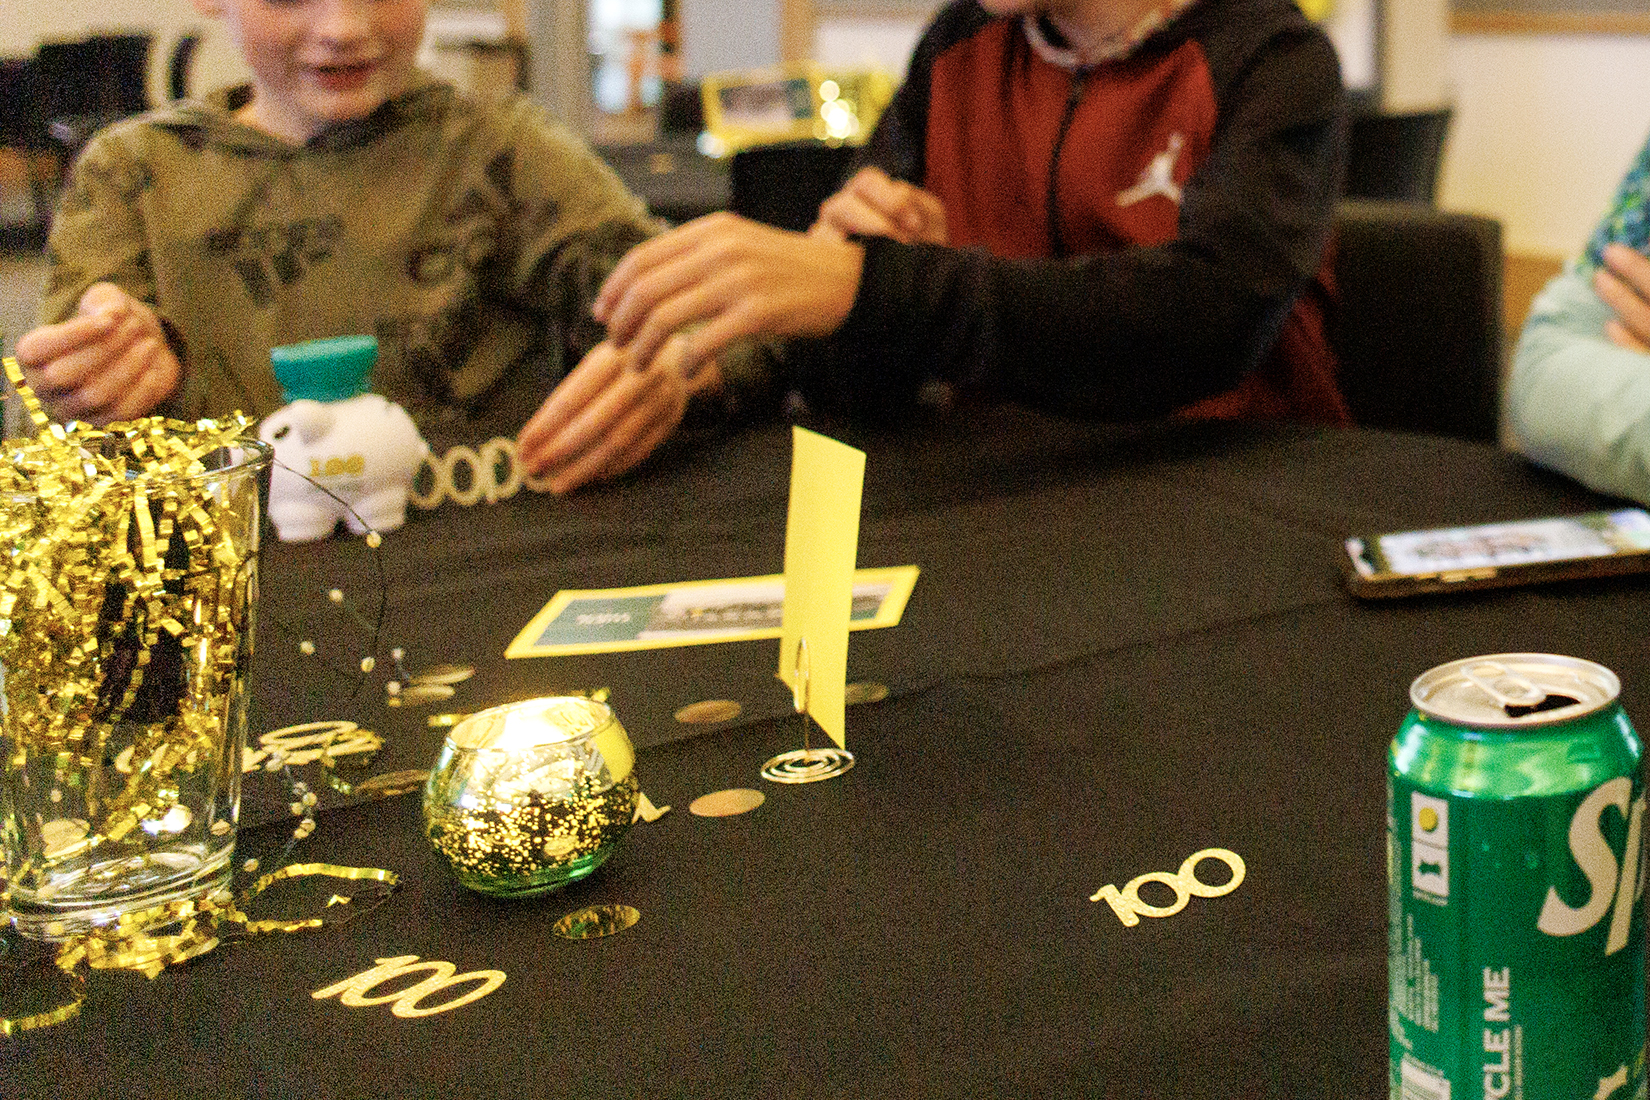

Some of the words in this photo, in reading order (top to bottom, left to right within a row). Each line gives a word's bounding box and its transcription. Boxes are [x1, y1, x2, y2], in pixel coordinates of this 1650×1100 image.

[1090, 848, 1246, 927] 100
[312, 955, 507, 1018] 100
[1483, 967, 1510, 1021] ME
[1483, 1029, 1510, 1100] CLE
